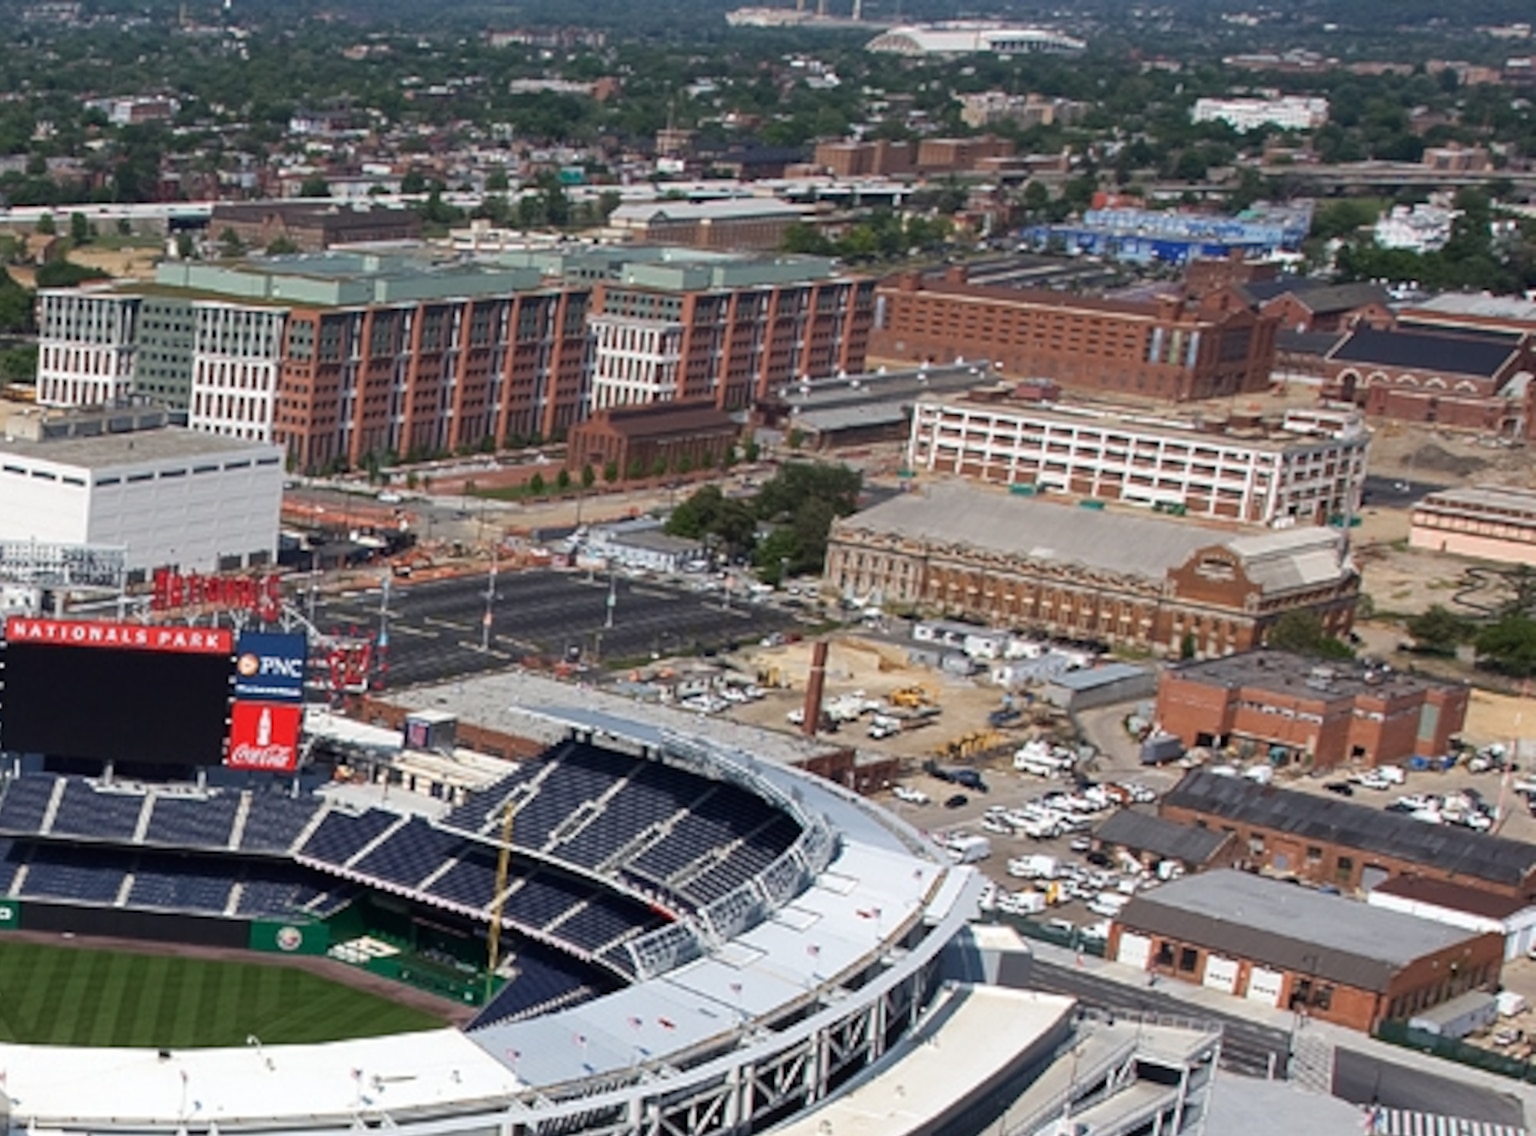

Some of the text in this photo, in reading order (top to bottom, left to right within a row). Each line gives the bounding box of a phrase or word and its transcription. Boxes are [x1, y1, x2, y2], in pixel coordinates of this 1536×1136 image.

[13, 623, 219, 648] NATIONALS PARK
[259, 656, 303, 678] PNC
